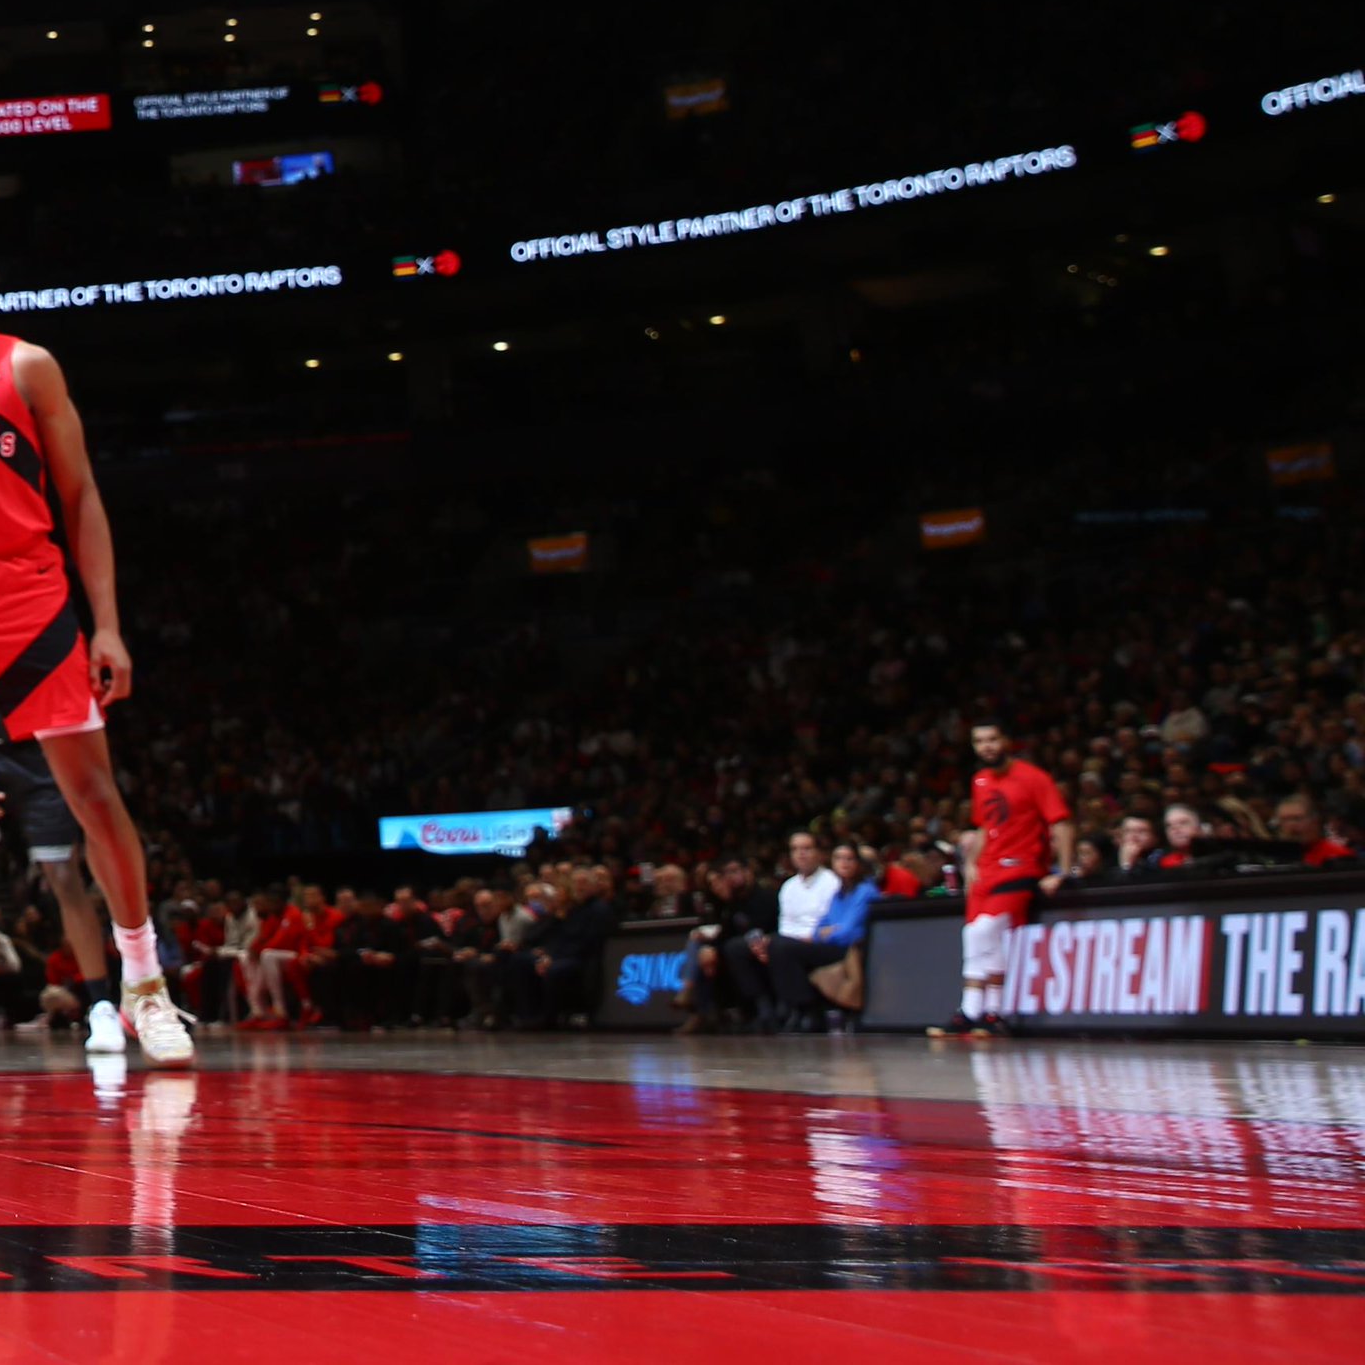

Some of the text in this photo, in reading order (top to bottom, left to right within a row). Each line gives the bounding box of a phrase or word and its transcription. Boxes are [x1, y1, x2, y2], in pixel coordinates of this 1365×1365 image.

[24, 117, 72, 133] LEVEL
[37, 99, 65, 115] ON
[67, 96, 99, 113] THE
[510, 145, 1077, 262] OFFICIAL STYLE PARTNER OF THE TORONTO RAPTORS
[69, 283, 101, 307] OF
[102, 281, 145, 304] THE
[146, 273, 245, 301] TORONTO
[244, 265, 342, 292] RAPTORS
[1045, 915, 1206, 1015] STREAM
[1221, 911, 1308, 1015] THE
